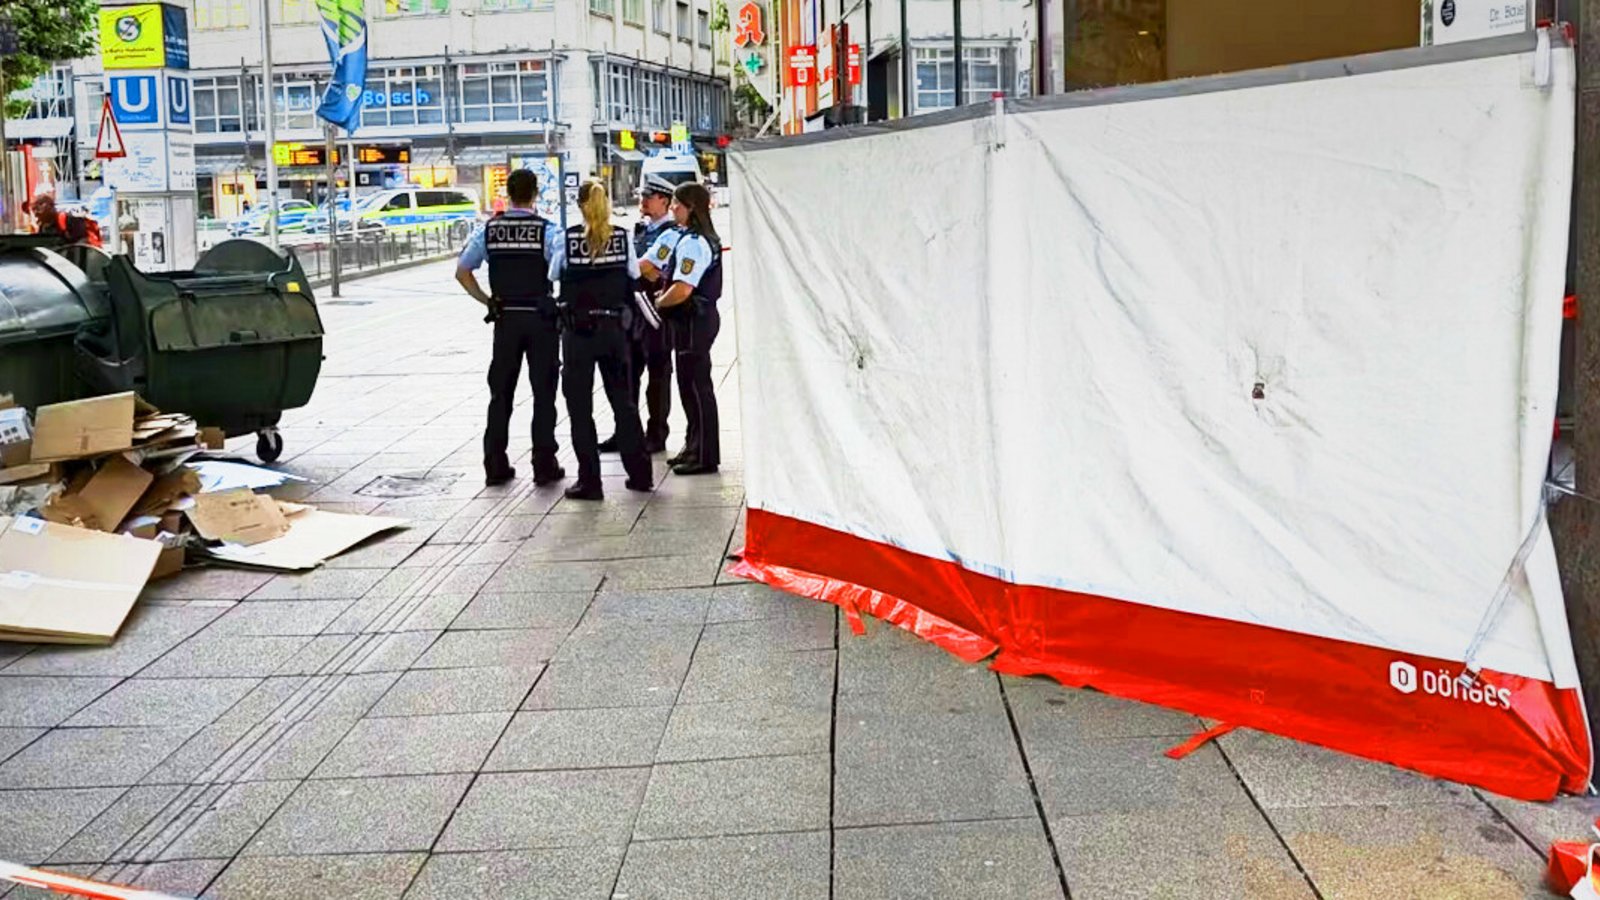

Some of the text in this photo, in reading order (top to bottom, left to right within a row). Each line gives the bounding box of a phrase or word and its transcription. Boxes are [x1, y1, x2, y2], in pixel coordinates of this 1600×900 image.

[117, 78, 150, 113] U
[170, 78, 187, 113] U
[362, 88, 430, 106] Bosch
[488, 226, 542, 242] POLIZEI
[569, 237, 626, 256] POZEI
